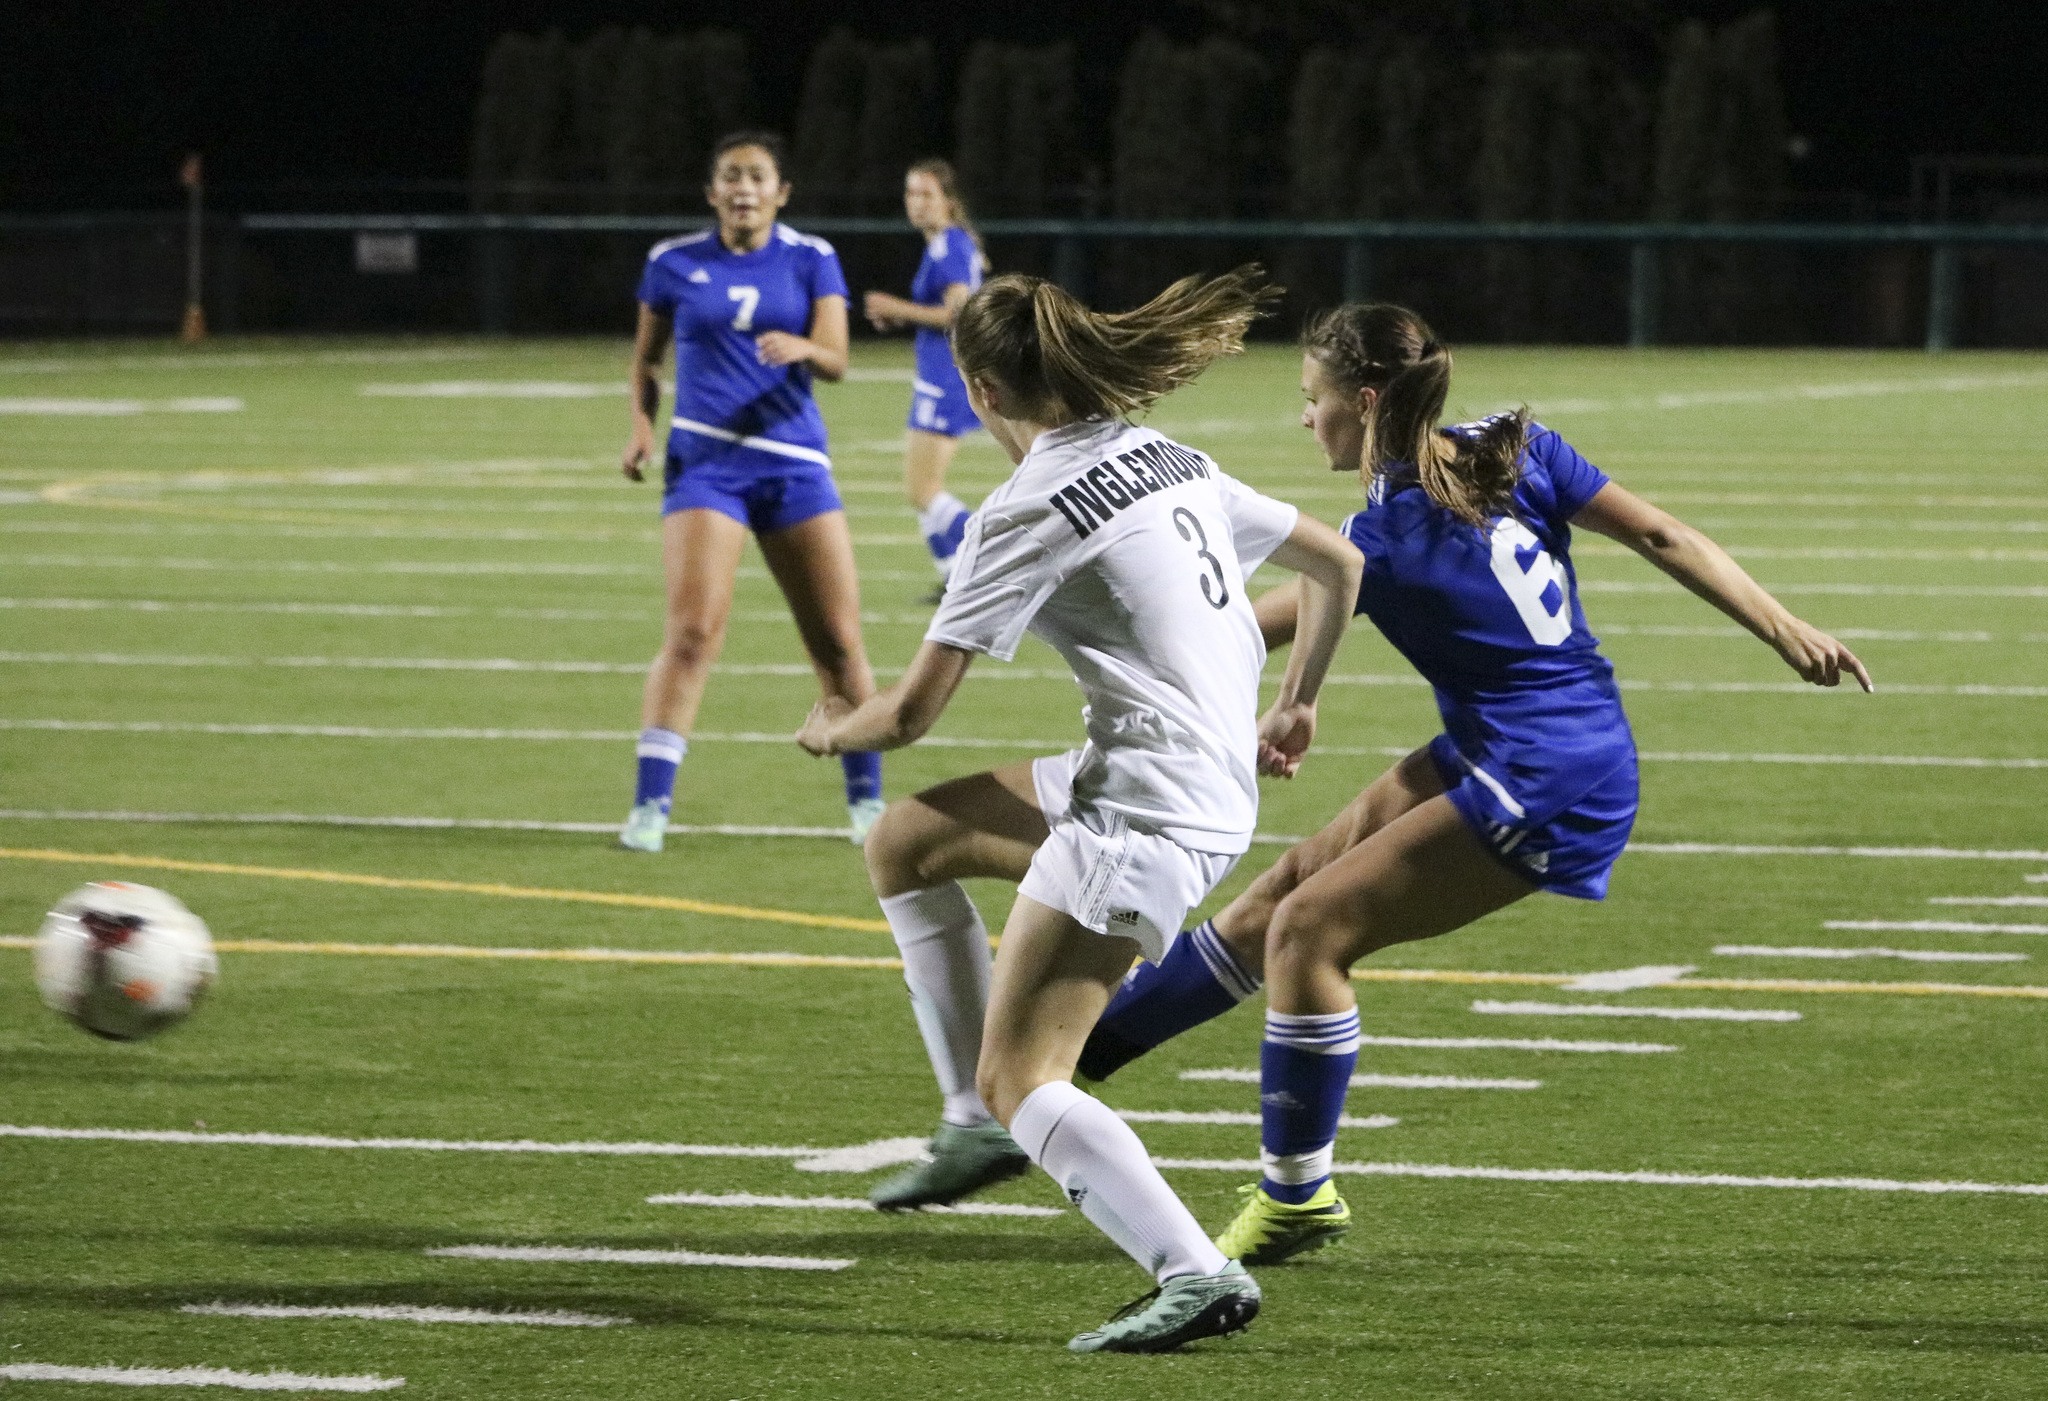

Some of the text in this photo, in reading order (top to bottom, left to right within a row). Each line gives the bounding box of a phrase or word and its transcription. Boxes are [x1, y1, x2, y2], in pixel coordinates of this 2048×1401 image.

[728, 285, 760, 331] 7
[1172, 507, 1229, 610] 3
[1490, 517, 1572, 646] 6
